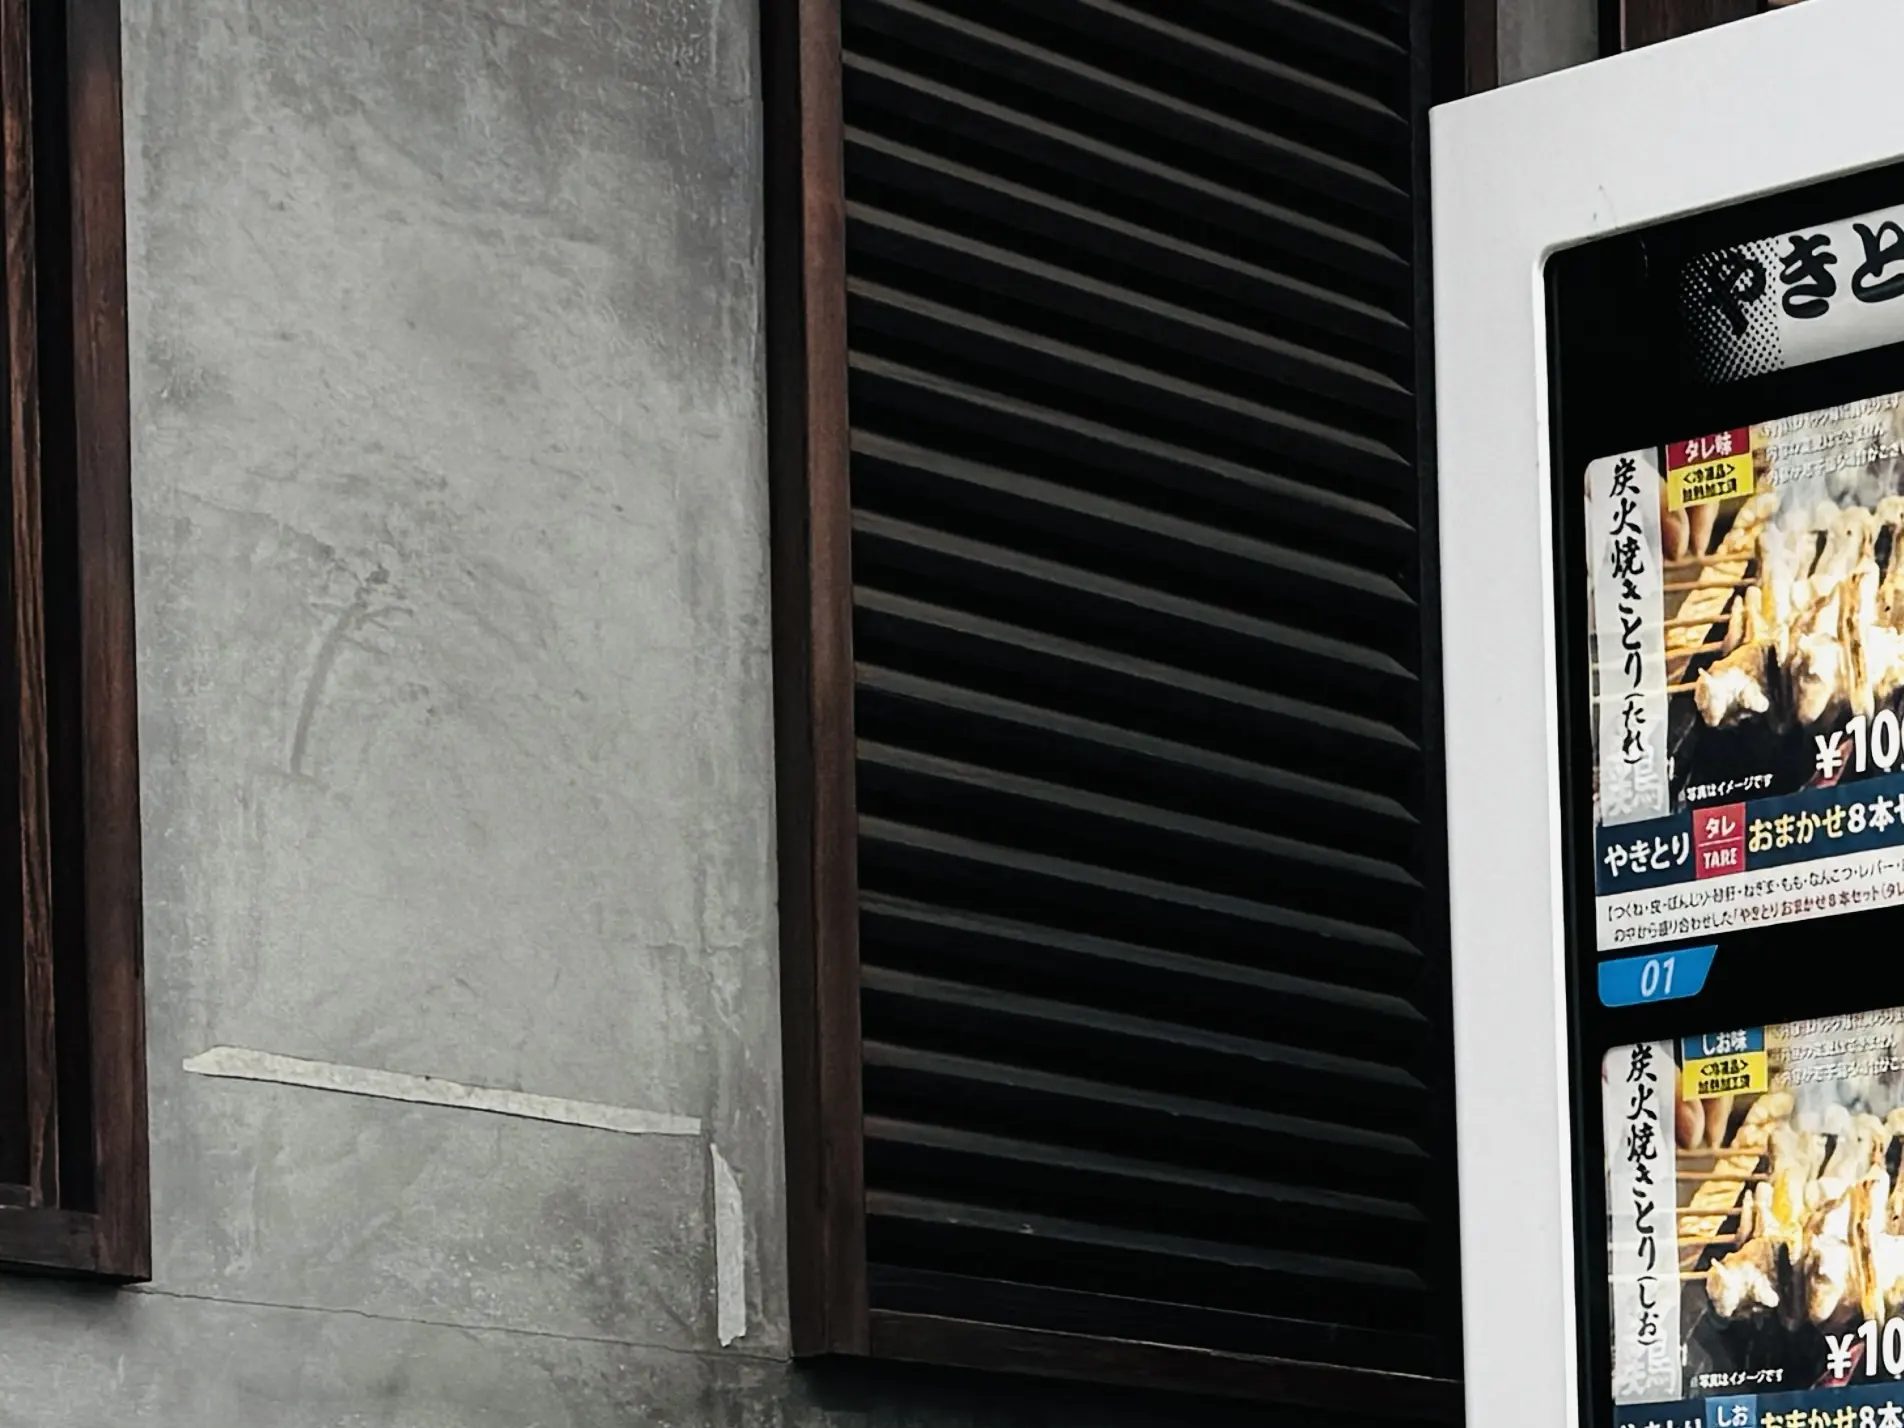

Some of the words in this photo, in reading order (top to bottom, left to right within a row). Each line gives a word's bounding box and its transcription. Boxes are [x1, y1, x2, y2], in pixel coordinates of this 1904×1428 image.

[1705, 815, 1736, 837] タレ
[1604, 832, 1690, 878] やきとり
[1702, 847, 1738, 870] TARE
[1640, 956, 1675, 998] 01
[1716, 1403, 1748, 1427] しお
